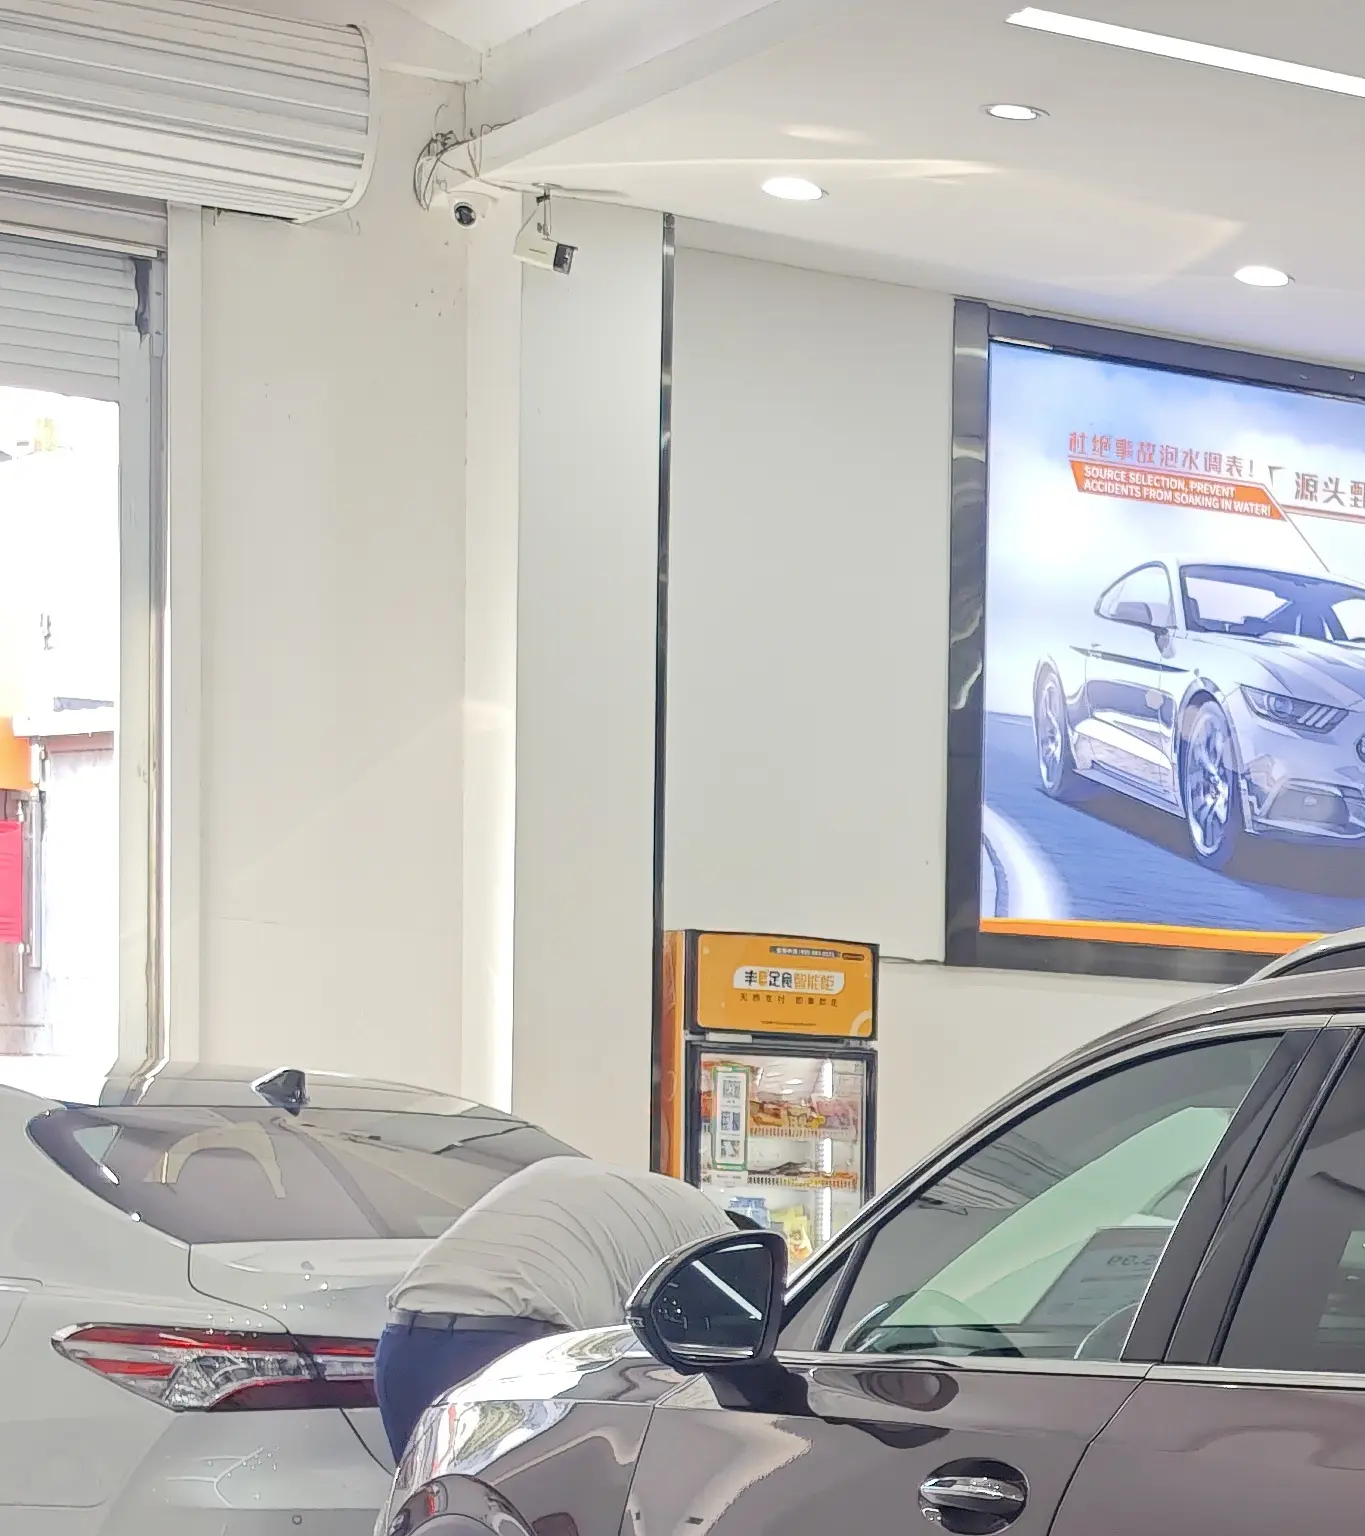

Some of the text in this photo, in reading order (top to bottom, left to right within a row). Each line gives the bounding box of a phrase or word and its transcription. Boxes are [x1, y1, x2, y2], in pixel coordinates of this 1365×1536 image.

[1084, 464, 1236, 498] SOURCE SELECTION, PREVENT
[1084, 479, 1141, 498] ACCIDENTS
[1143, 486, 1173, 502] FROM
[1174, 491, 1220, 509] SOAKING
[1221, 499, 1233, 512] IN
